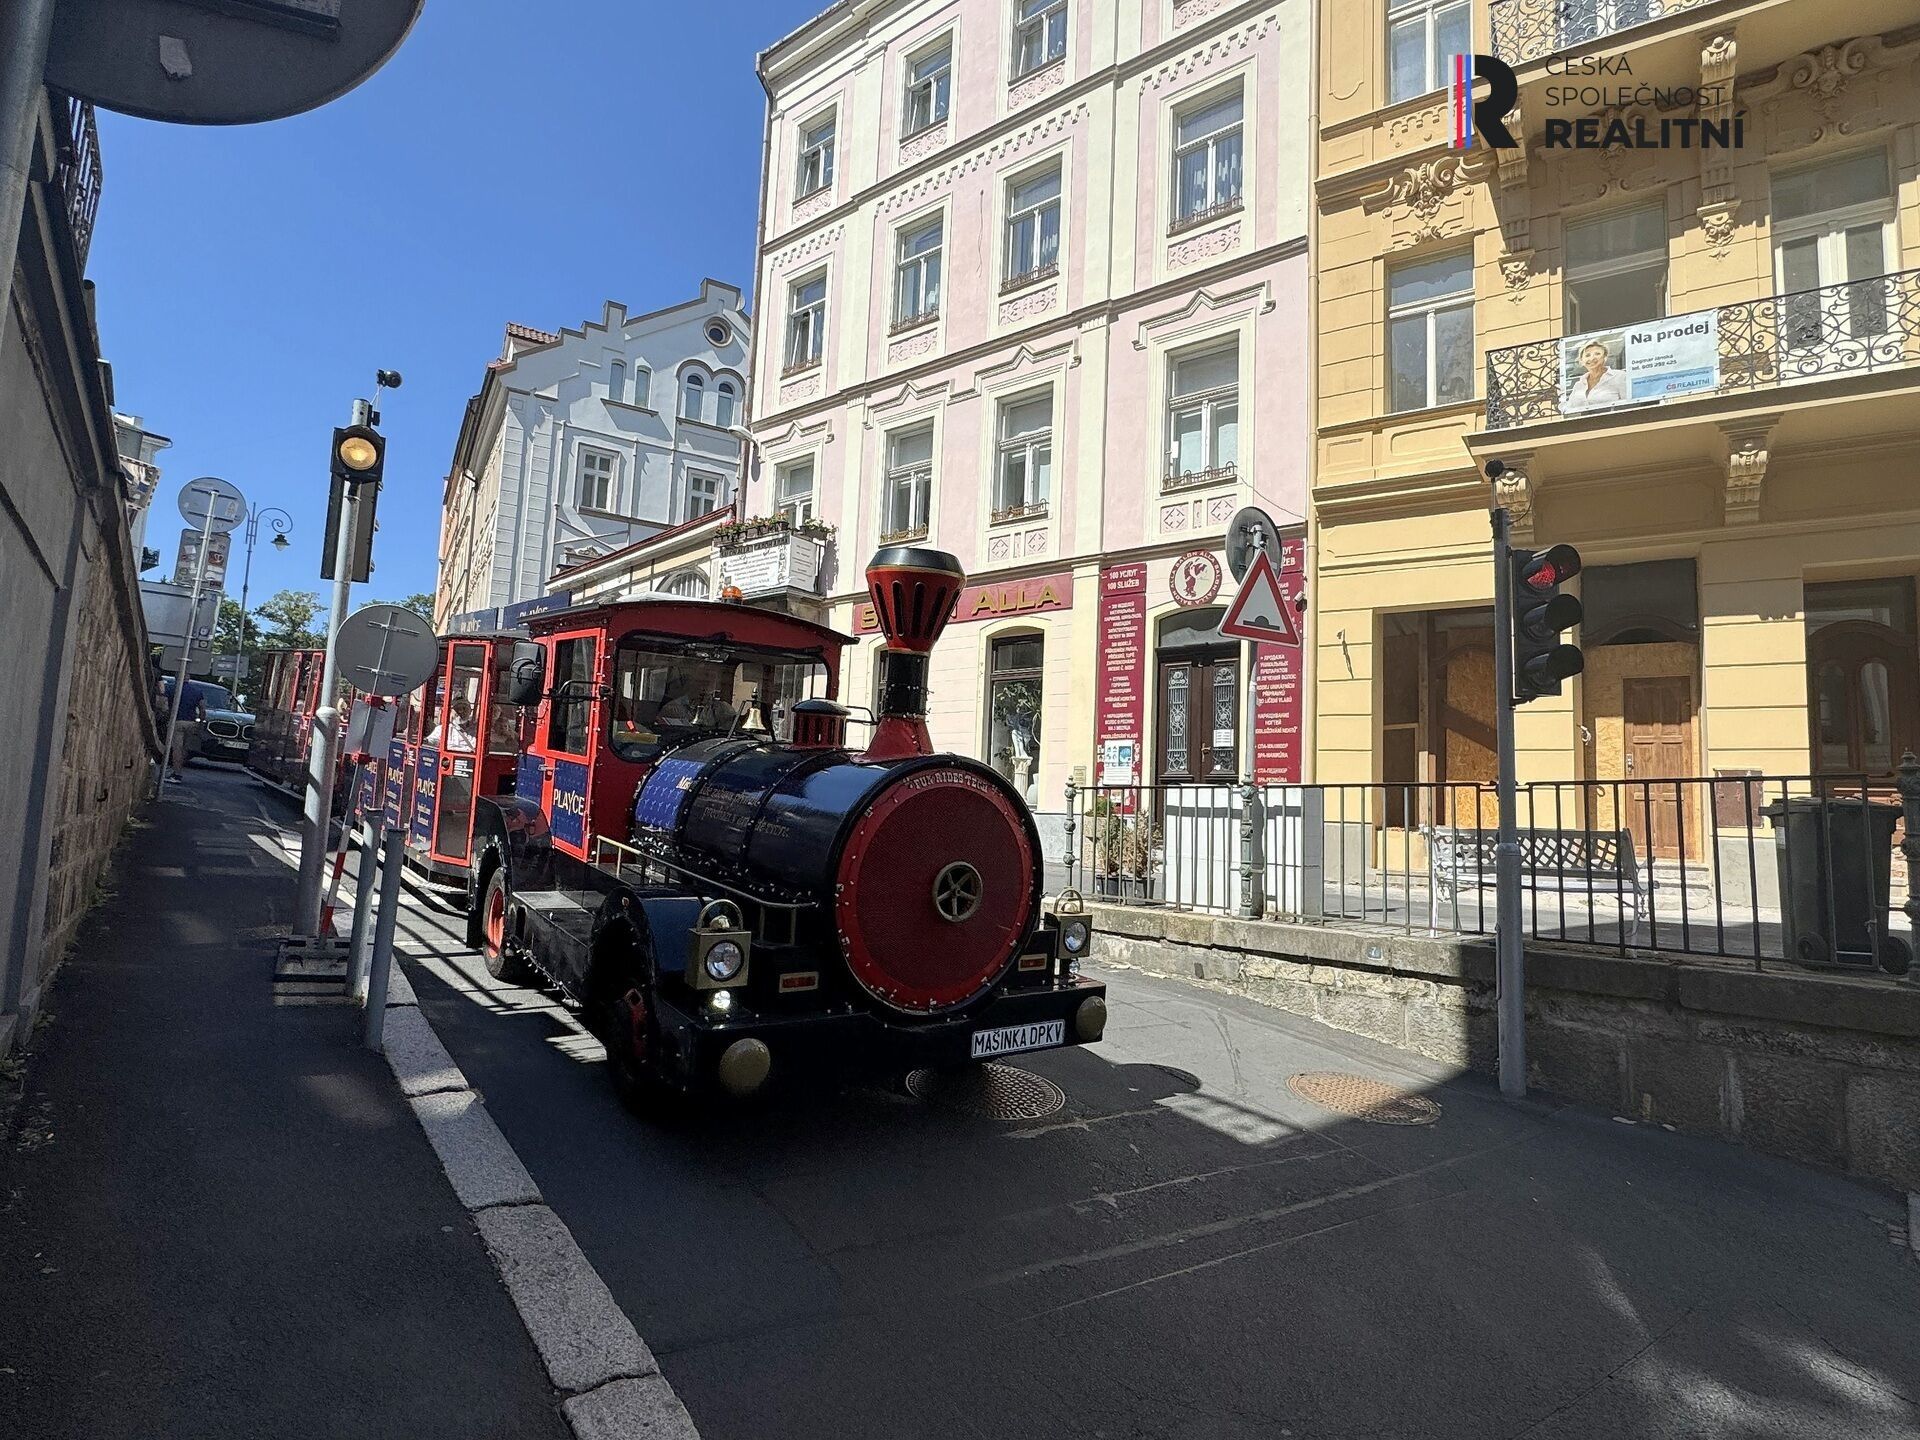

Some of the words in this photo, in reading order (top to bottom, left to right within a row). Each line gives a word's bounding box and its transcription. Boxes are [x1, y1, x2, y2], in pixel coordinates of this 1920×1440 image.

[1631, 333, 1652, 345] Na
[1657, 321, 1710, 343] prodej
[1107, 581, 1117, 590] 100
[1117, 578, 1140, 589] SLUŽEB
[1109, 571, 1119, 580] 100
[1119, 569, 1138, 579] УСЛУГ
[971, 585, 1061, 617] ALLA
[913, 775, 934, 789] FUN
[935, 772, 964, 784] RIDES
[964, 775, 989, 793] TECH
[553, 789, 585, 816] PLAYCE
[973, 1028, 1027, 1055] MAŠINKA
[1029, 1022, 1063, 1046] DPKV
